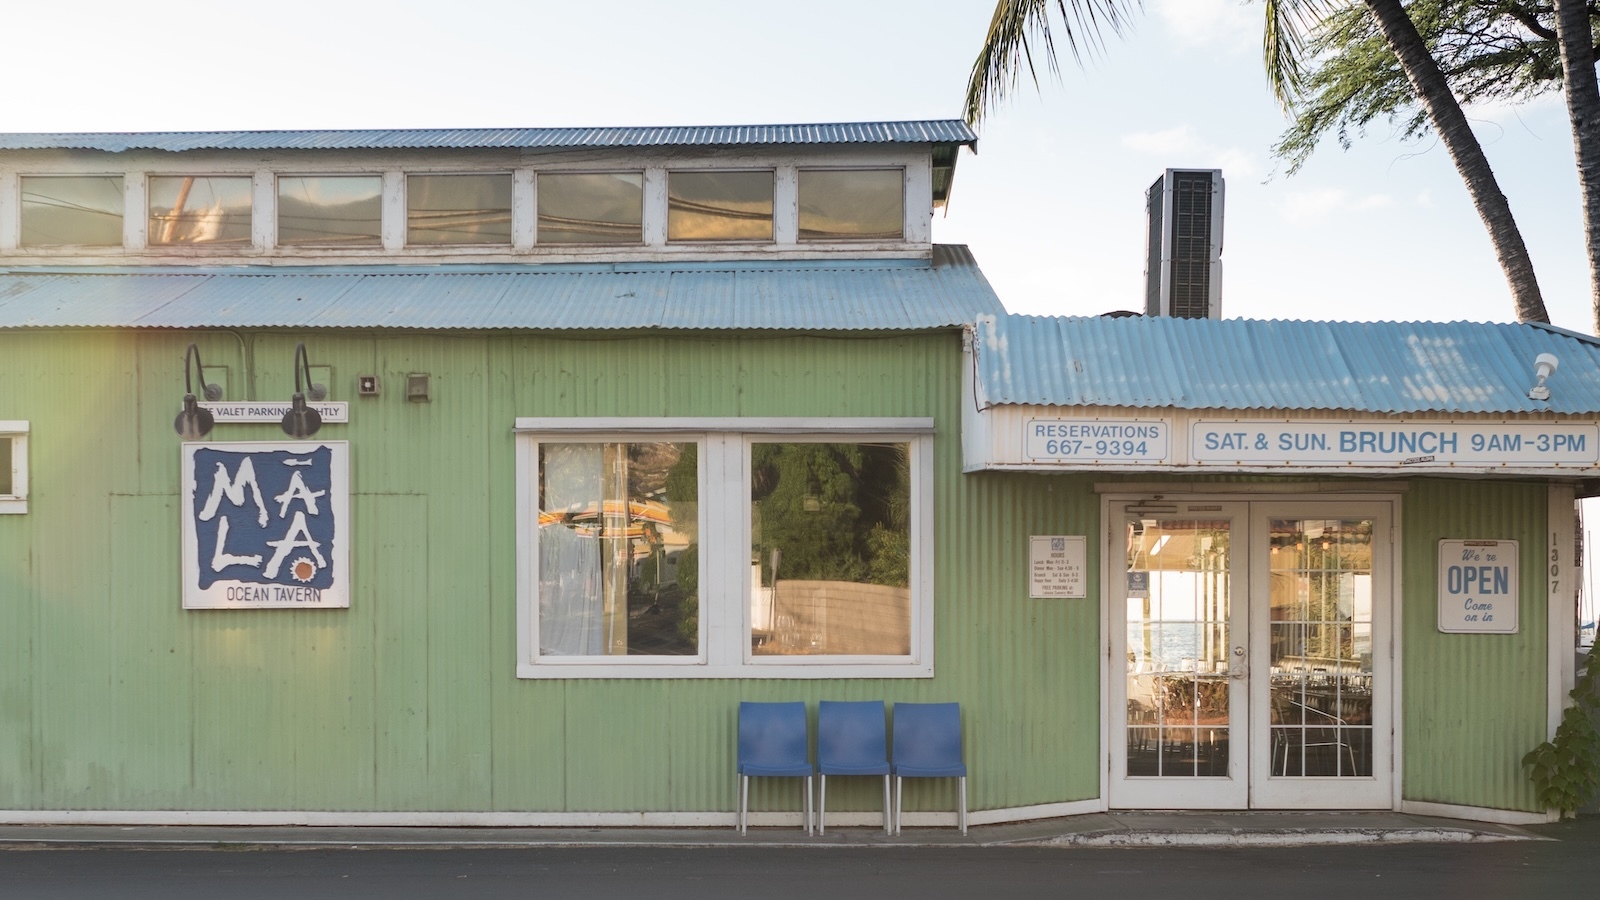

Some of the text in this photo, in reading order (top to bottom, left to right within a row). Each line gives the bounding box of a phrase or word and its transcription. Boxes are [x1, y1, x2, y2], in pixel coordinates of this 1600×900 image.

[217, 407, 245, 416] VALET
[1035, 424, 1159, 439] RESERVATIONS
[1046, 439, 1148, 456] 667-9394
[1204, 430, 1586, 454] SAT. & SUN. BRUNCH 9AM-3PM
[1448, 565, 1509, 595] OPEN
[227, 586, 322, 603] OCEAN TAVERN
[1464, 598, 1493, 611] Come
[1464, 612, 1493, 622] on in
